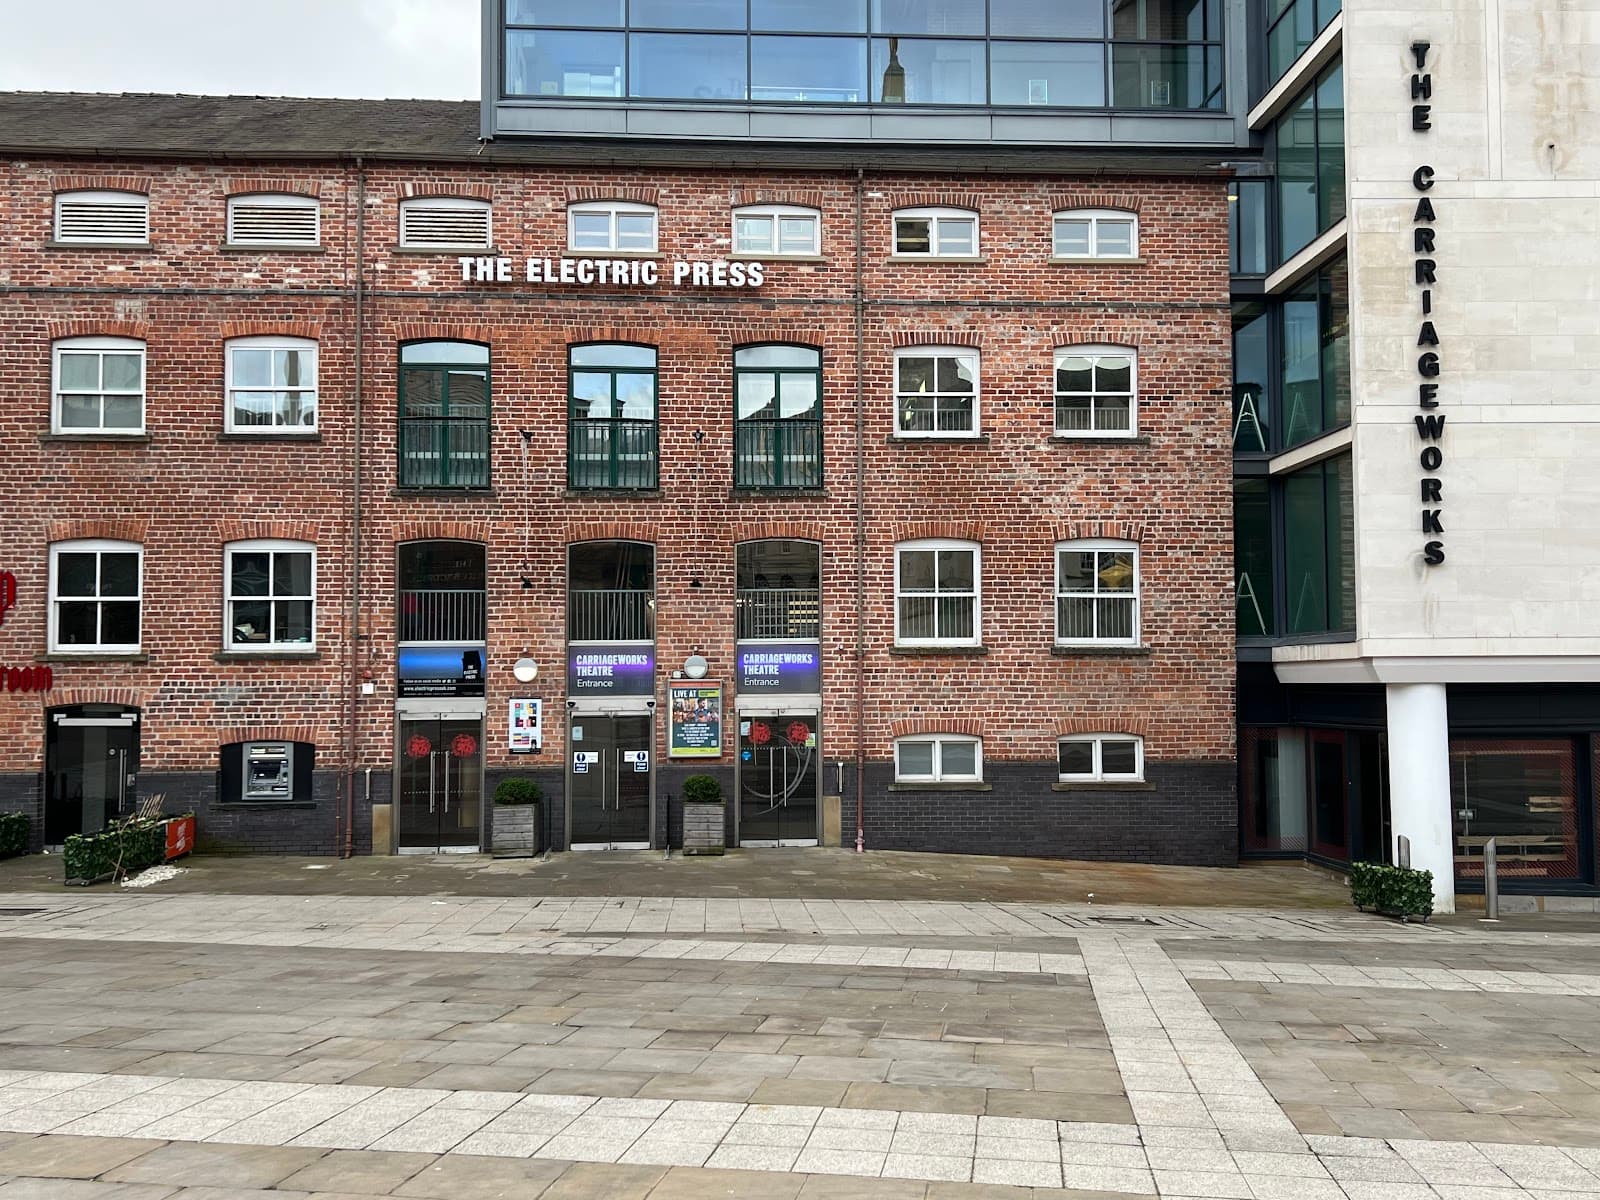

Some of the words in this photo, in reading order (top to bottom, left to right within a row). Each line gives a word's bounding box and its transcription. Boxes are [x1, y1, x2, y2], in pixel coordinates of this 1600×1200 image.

[1410, 43, 1432, 131] THE
[458, 256, 512, 282] THE
[526, 258, 658, 286] ELECTRIC
[673, 261, 764, 287] PRESS
[1413, 165, 1446, 565] CARRIAGEWORKS
[576, 654, 648, 666] CARRIAGEWORKS
[743, 653, 813, 664] CARRIAGEWORKS
[576, 665, 614, 677] THEATRE
[743, 664, 780, 675] THEATRE
[577, 679, 614, 688] Entrance
[744, 677, 780, 686] Entrance
[673, 689, 688, 698] LIVE
[688, 689, 697, 698] AT
